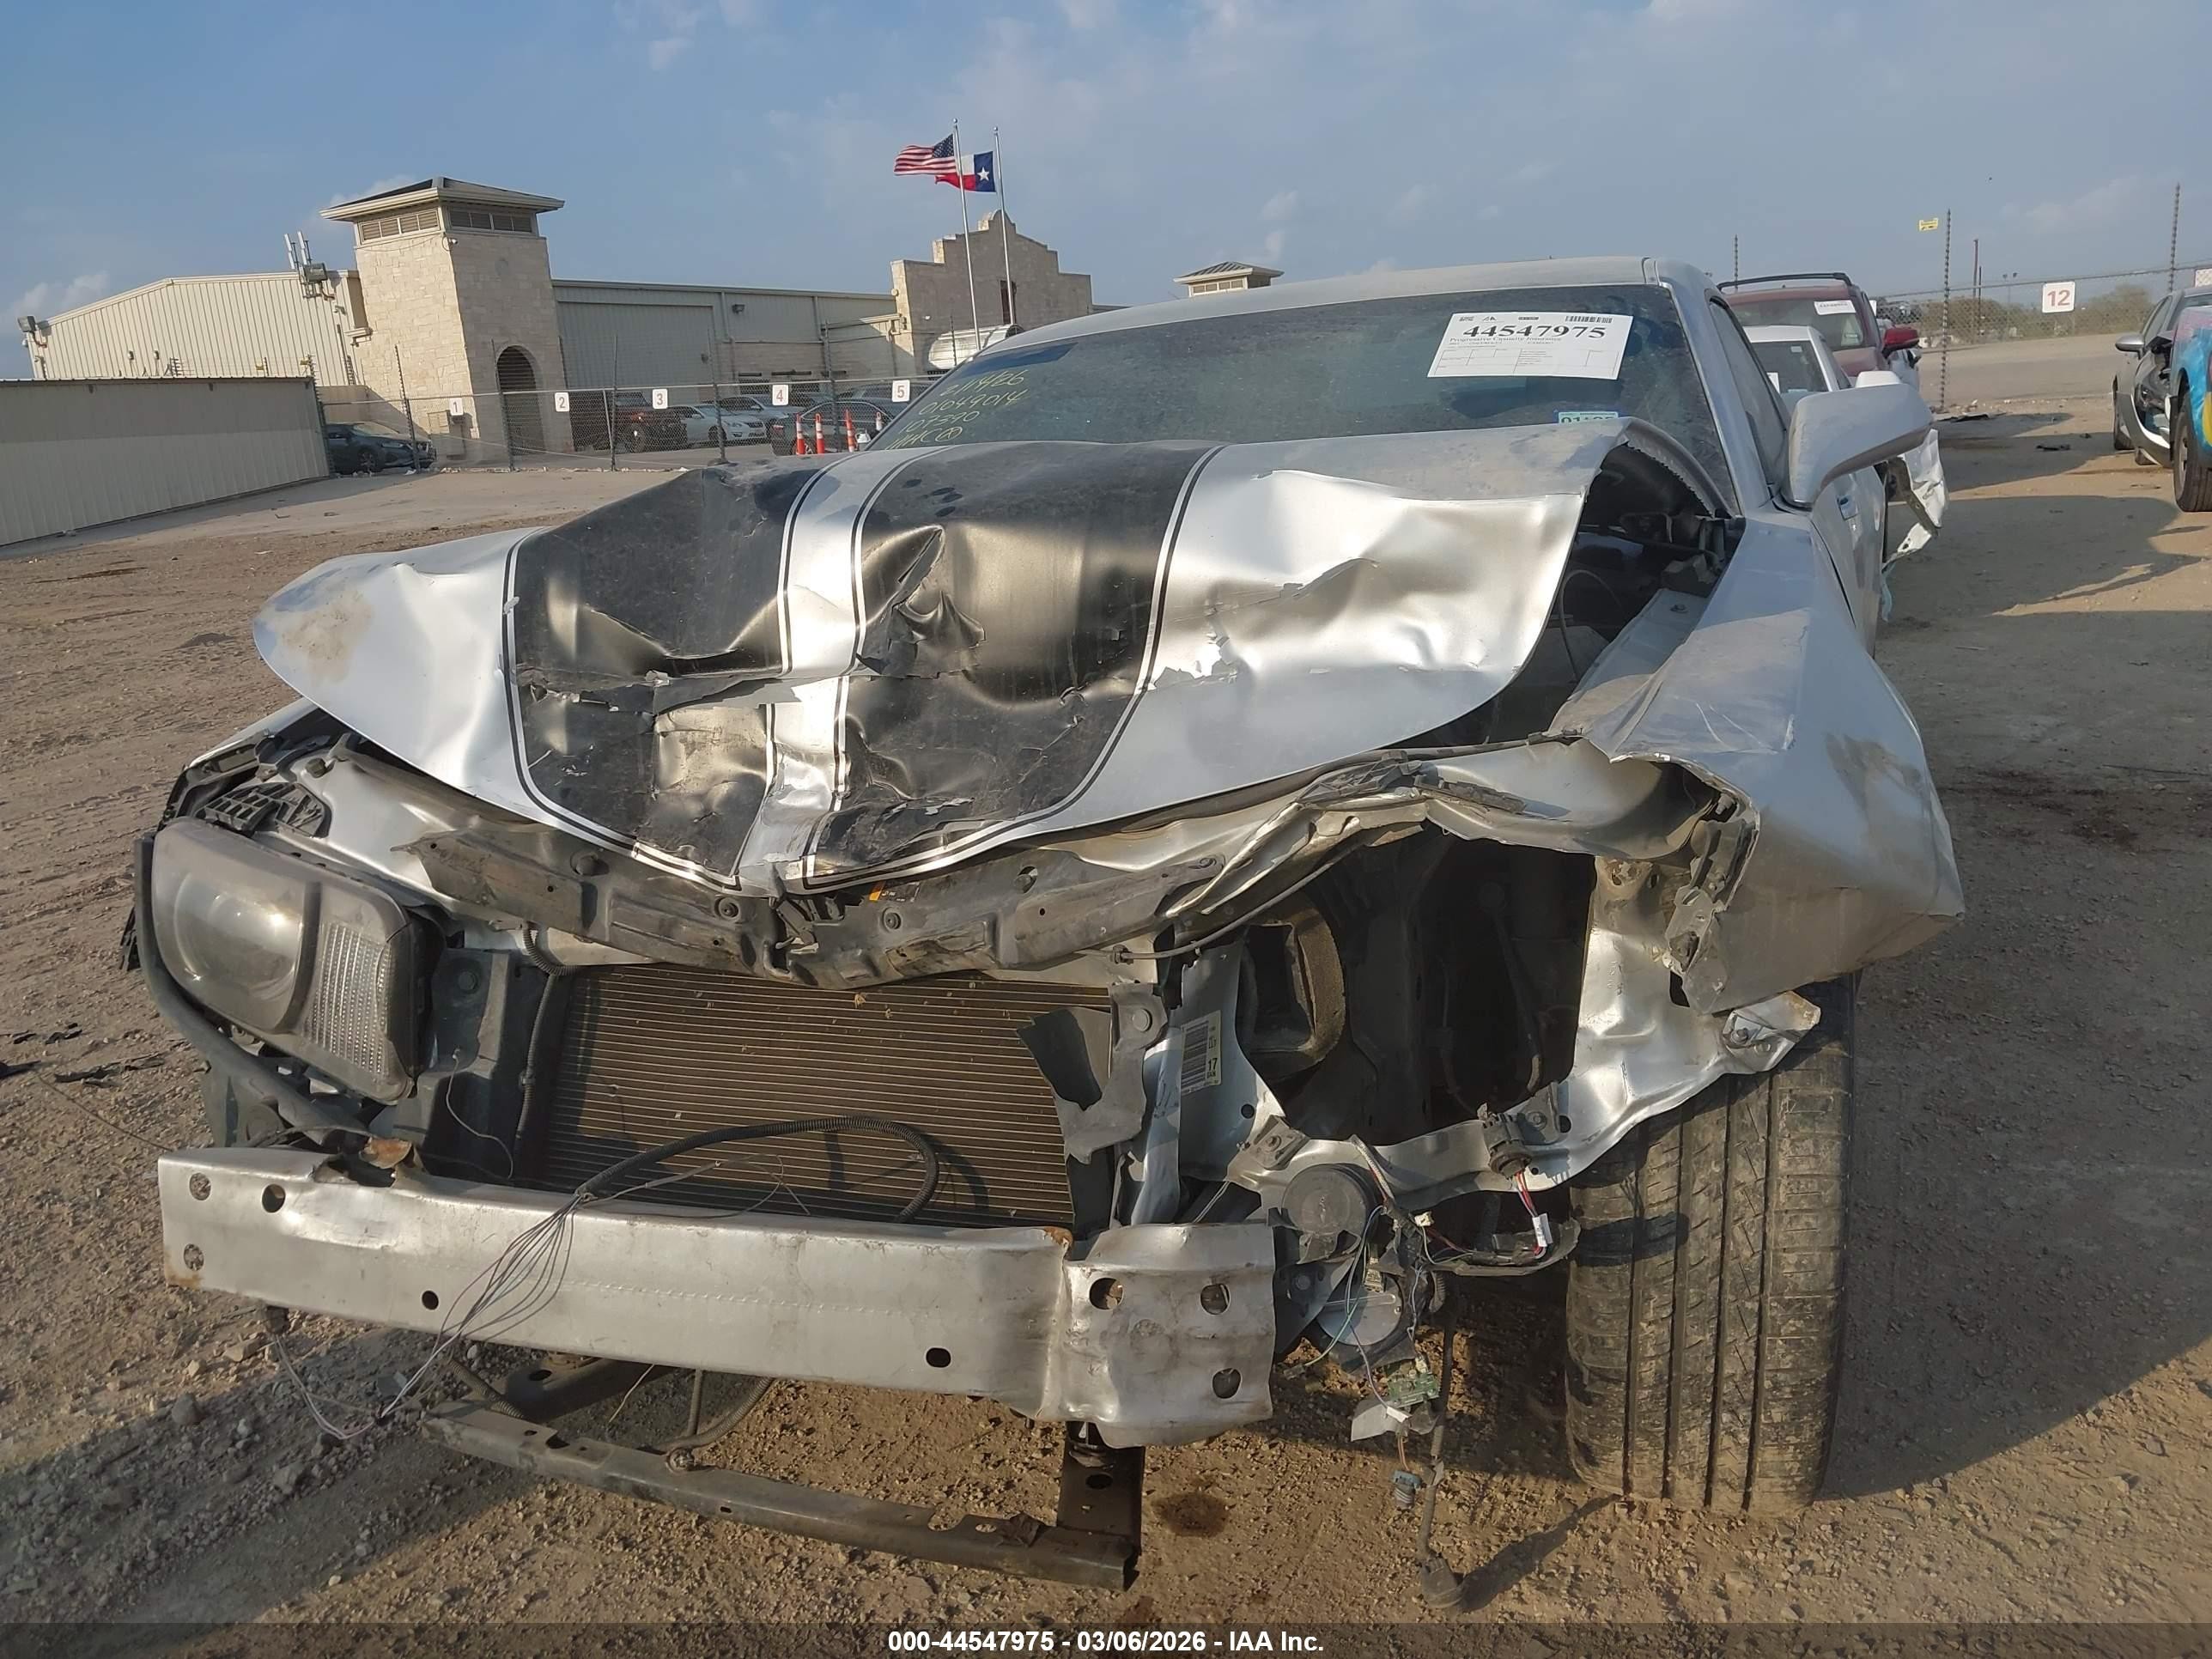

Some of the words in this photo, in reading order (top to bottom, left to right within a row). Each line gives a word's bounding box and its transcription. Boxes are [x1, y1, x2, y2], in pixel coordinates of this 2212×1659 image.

[2047, 289, 2070, 307] 12
[1462, 325, 1607, 338] 44547975
[775, 389, 784, 402] 4
[896, 386, 905, 398] 5
[558, 397, 566, 409] 2
[656, 392, 664, 406] 3
[453, 401, 458, 413] 1
